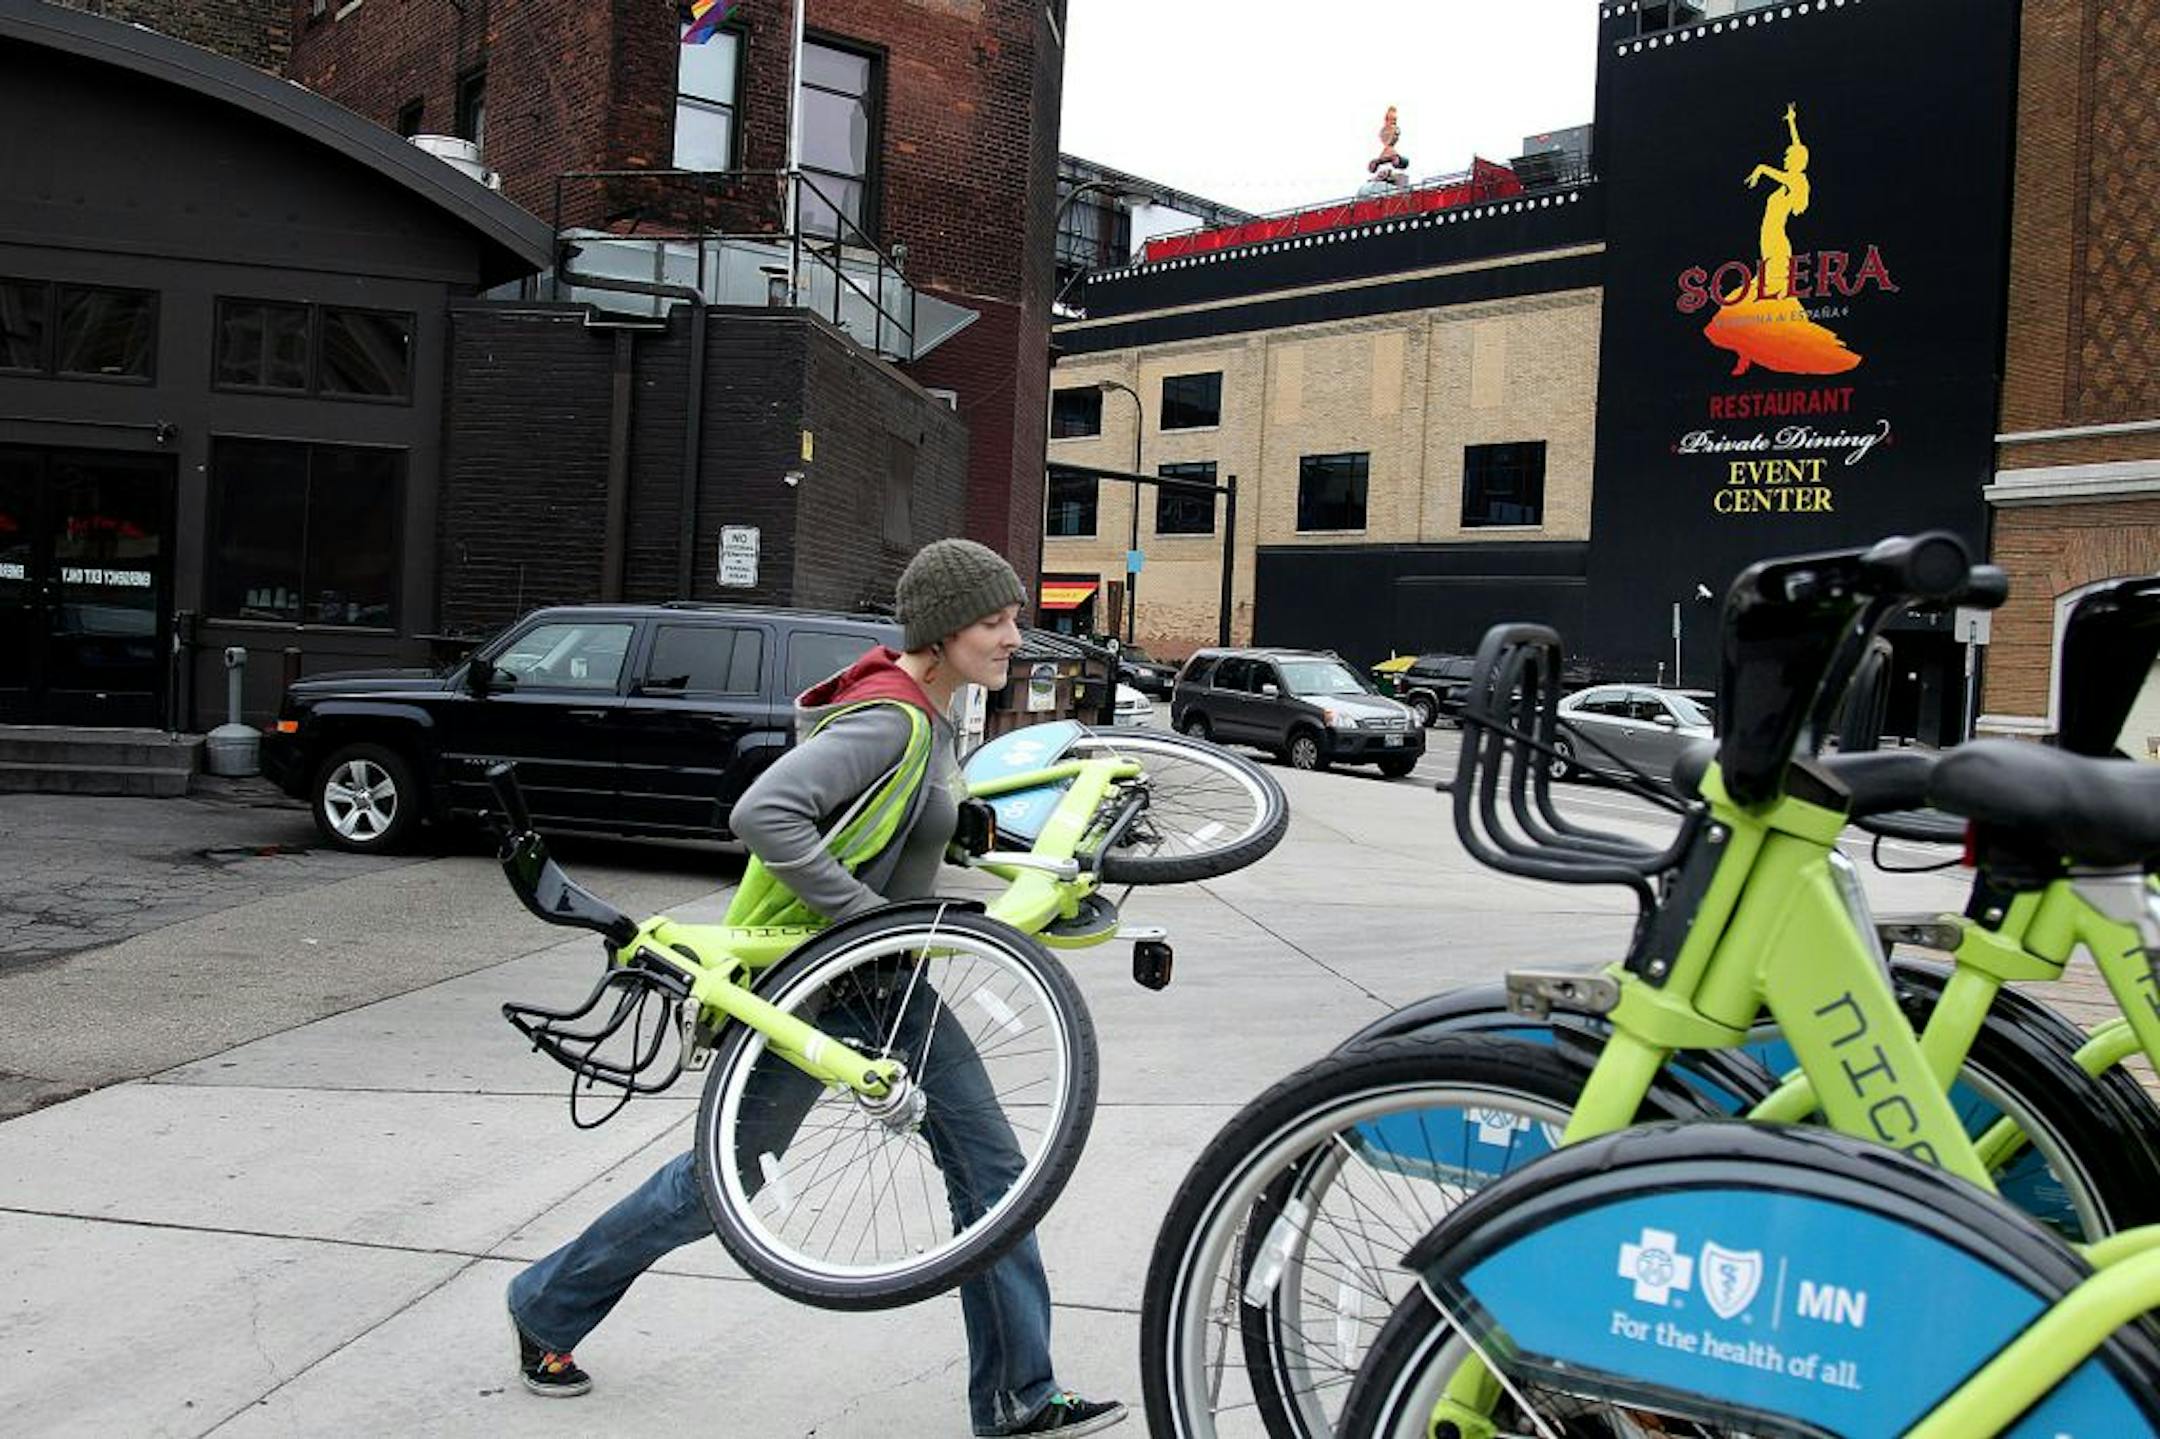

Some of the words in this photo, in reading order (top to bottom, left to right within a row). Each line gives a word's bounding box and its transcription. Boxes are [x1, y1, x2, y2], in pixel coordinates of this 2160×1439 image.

[1676, 244, 1900, 313] SOLERA
[1709, 387, 1855, 419] RESTAURANT
[1677, 430, 1770, 455] Private
[1773, 419, 1891, 466] Dining
[1728, 458, 1827, 485] EVENT
[1713, 487, 1833, 513] CENTER
[731, 533, 748, 544] NO
[1797, 1280, 1867, 1328] MN
[1610, 1311, 1650, 1341] For
[1655, 1322, 1698, 1353] the
[1701, 1329, 1785, 1373] health
[1787, 1353, 1820, 1380] of
[1821, 1360, 1862, 1391] all.
